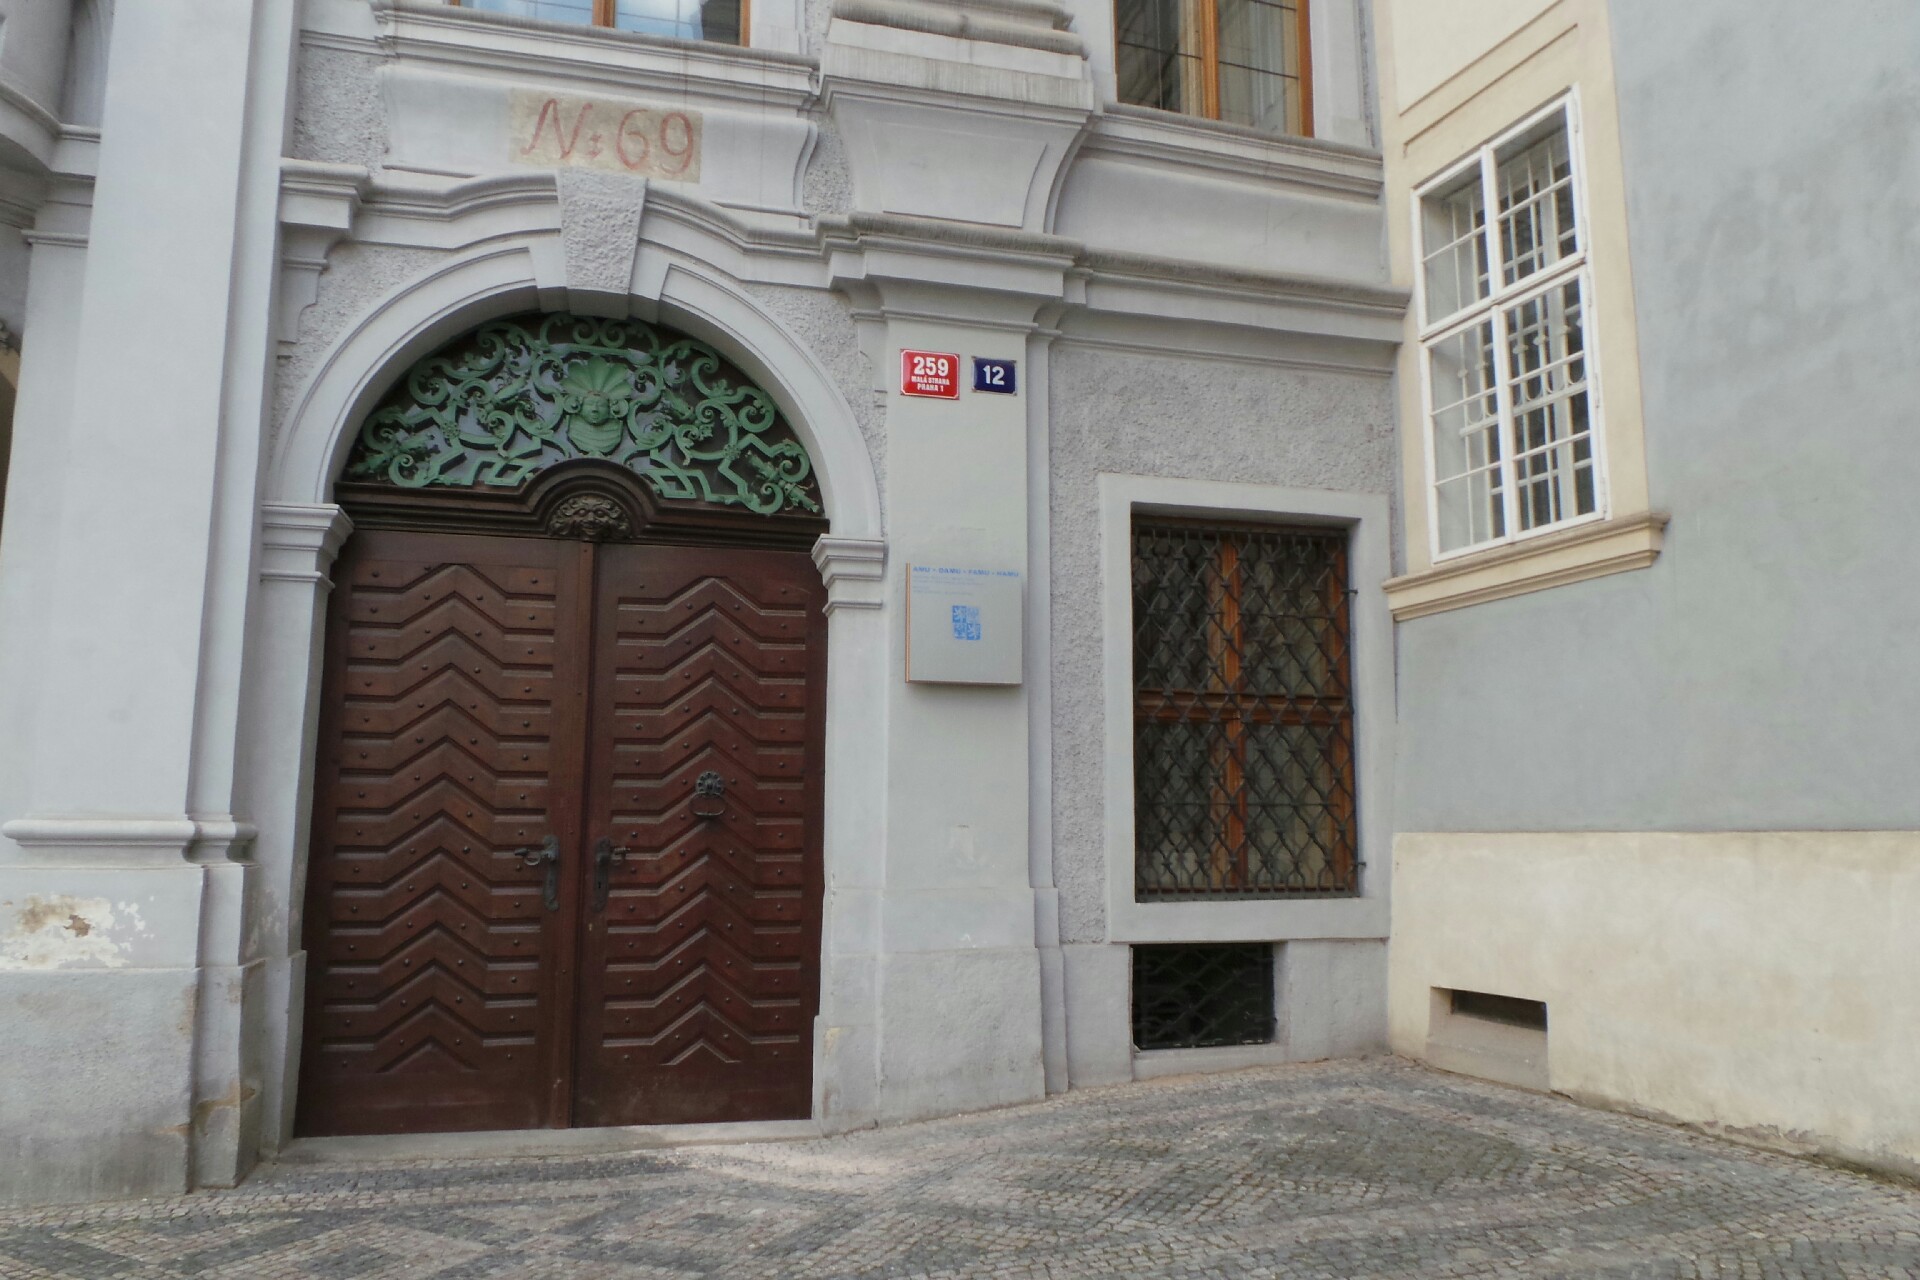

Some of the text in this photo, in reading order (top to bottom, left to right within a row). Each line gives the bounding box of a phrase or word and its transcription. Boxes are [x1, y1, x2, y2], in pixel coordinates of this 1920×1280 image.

[616, 109, 694, 175] 69
[913, 356, 949, 376] 259
[983, 365, 1005, 385] 12
[911, 375, 950, 385] MALÁ STRANA
[917, 383, 938, 391] PRAHA
